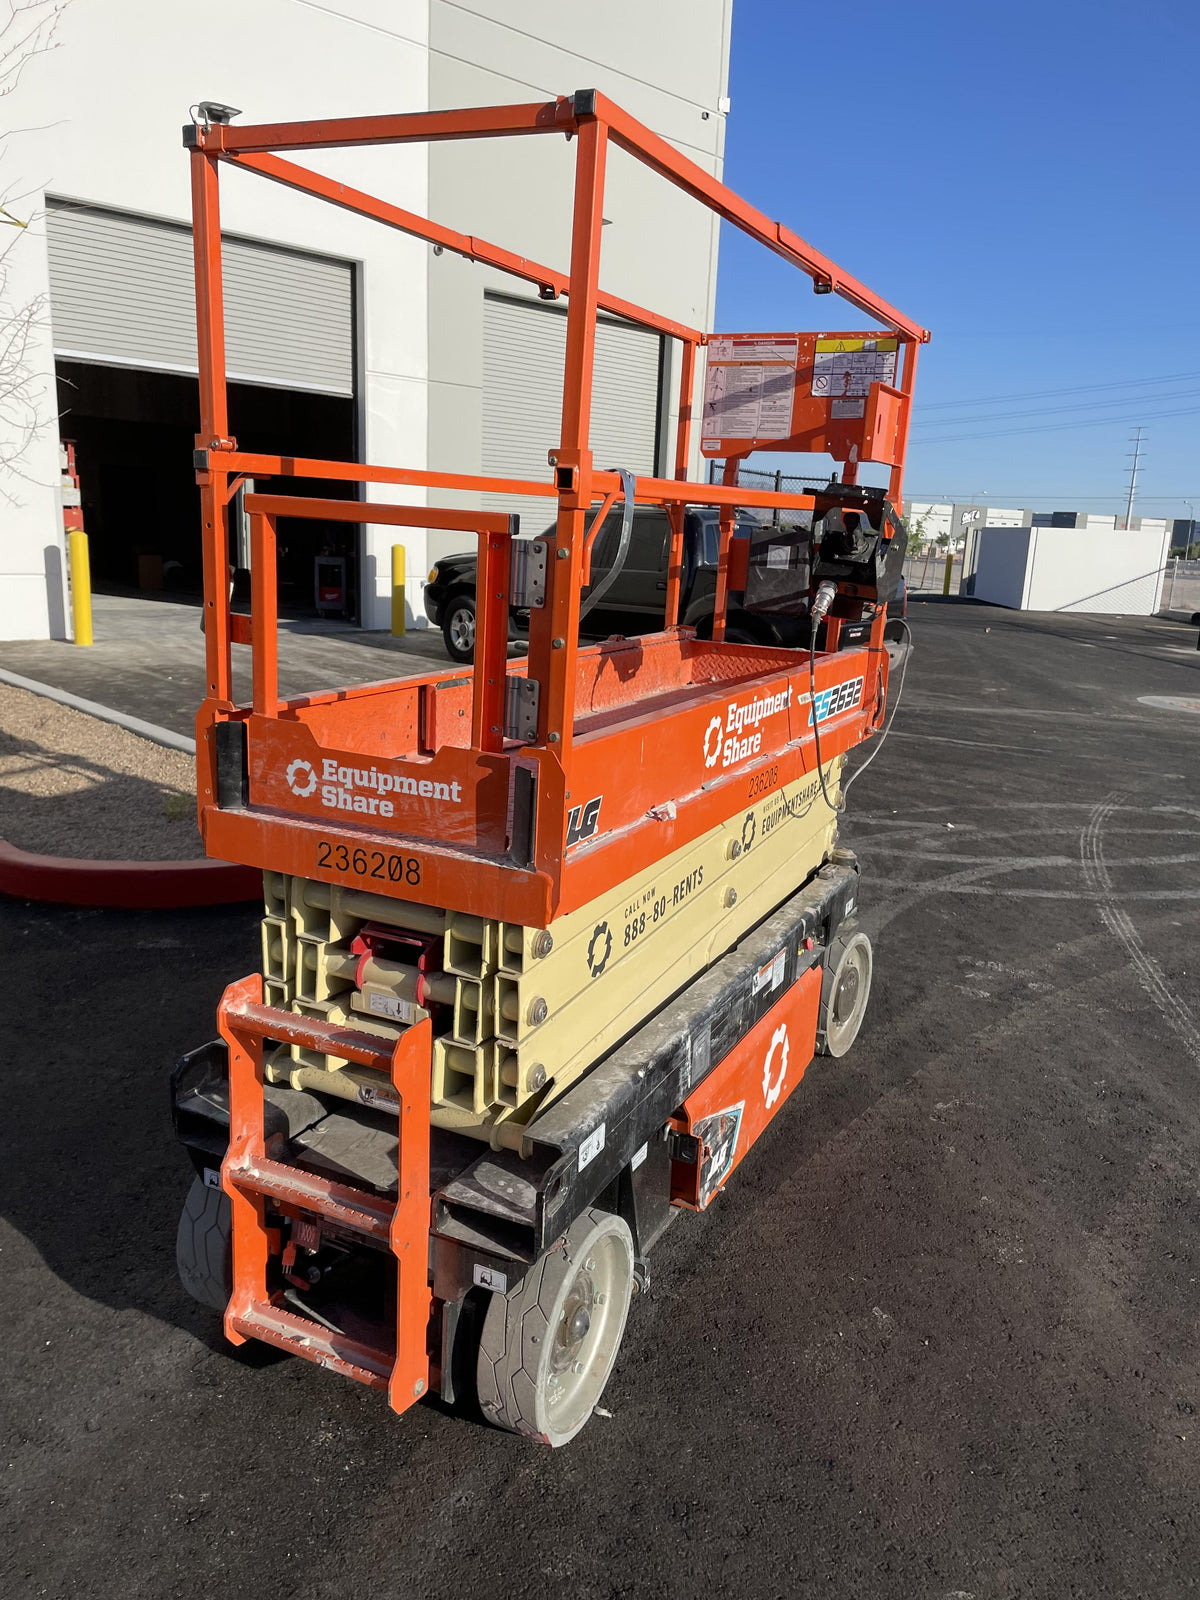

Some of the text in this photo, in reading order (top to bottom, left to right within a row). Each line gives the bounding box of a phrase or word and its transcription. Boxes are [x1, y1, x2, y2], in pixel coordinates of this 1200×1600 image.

[725, 685, 793, 735] Equipment
[808, 675, 864, 727] ES2632
[722, 731, 762, 767] Share
[321, 758, 462, 803] Equipment
[321, 785, 394, 818] Share
[748, 766, 779, 798] 236208
[317, 841, 421, 886] 236208
[623, 865, 704, 947] 888-80-RENTS
[624, 886, 656, 919] CALL NOW
